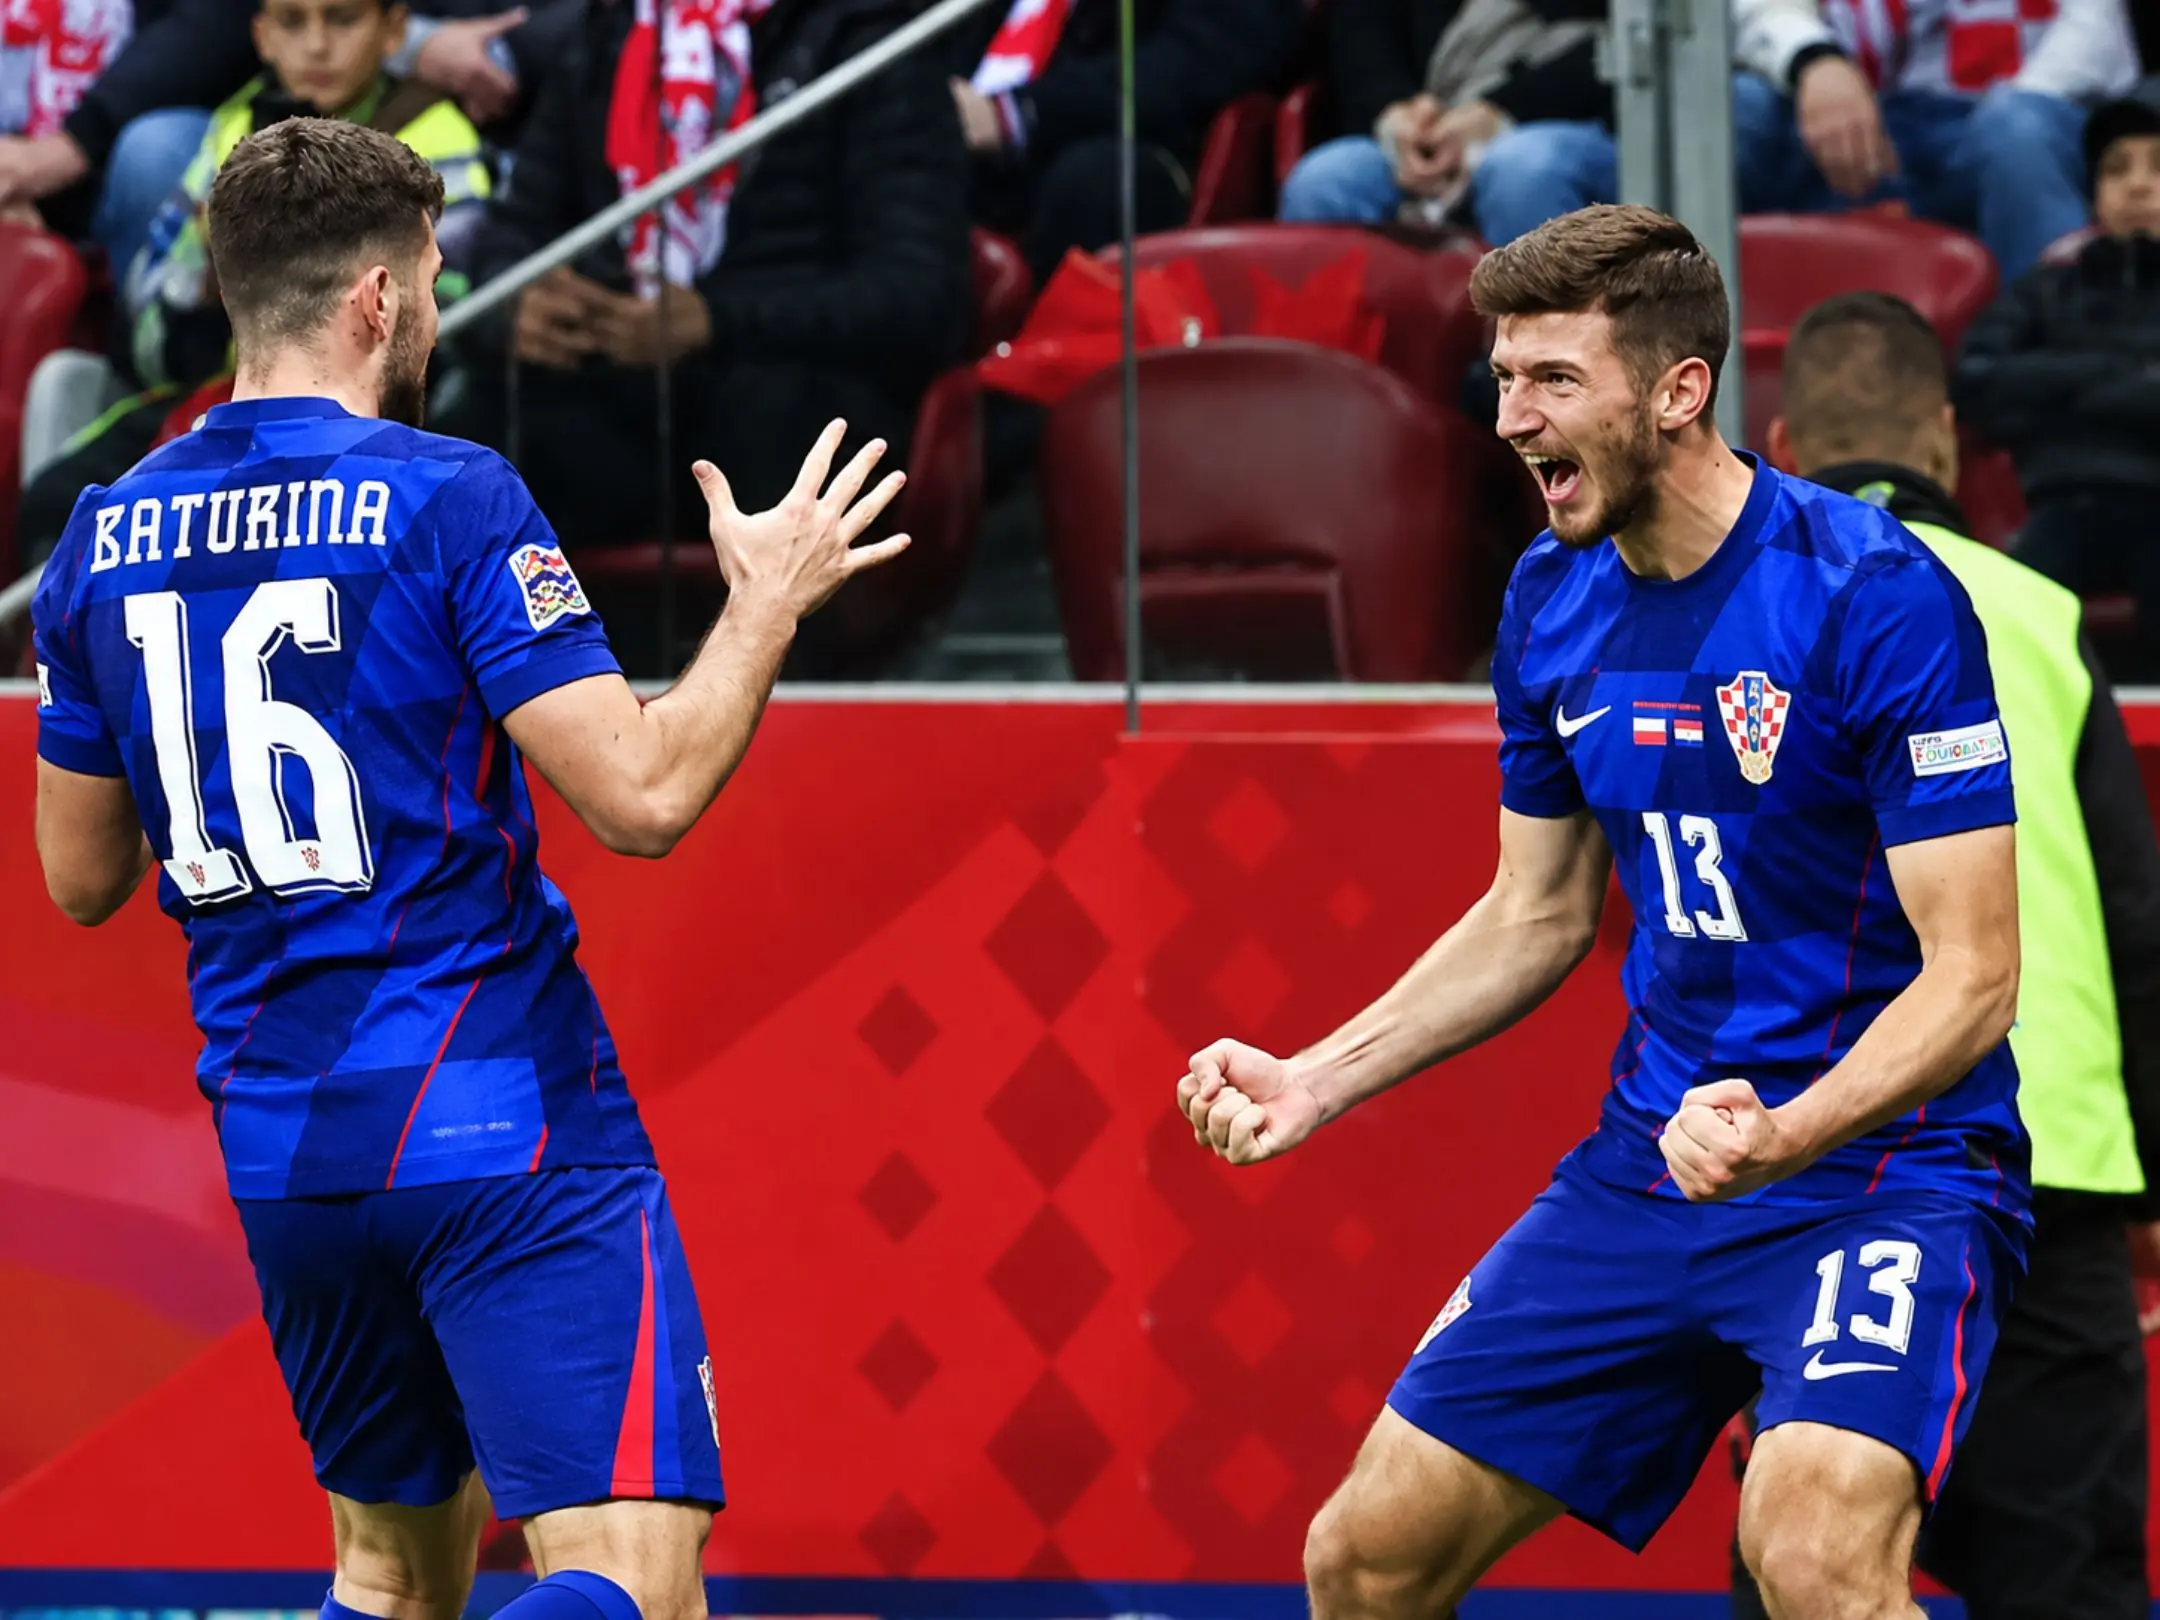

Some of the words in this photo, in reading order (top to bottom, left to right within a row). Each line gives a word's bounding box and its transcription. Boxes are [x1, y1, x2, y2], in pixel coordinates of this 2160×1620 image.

[89, 478, 391, 574] BATURINA
[124, 578, 374, 905] 16
[1642, 811, 1748, 943] 13
[1802, 1239, 1922, 1355] 13
